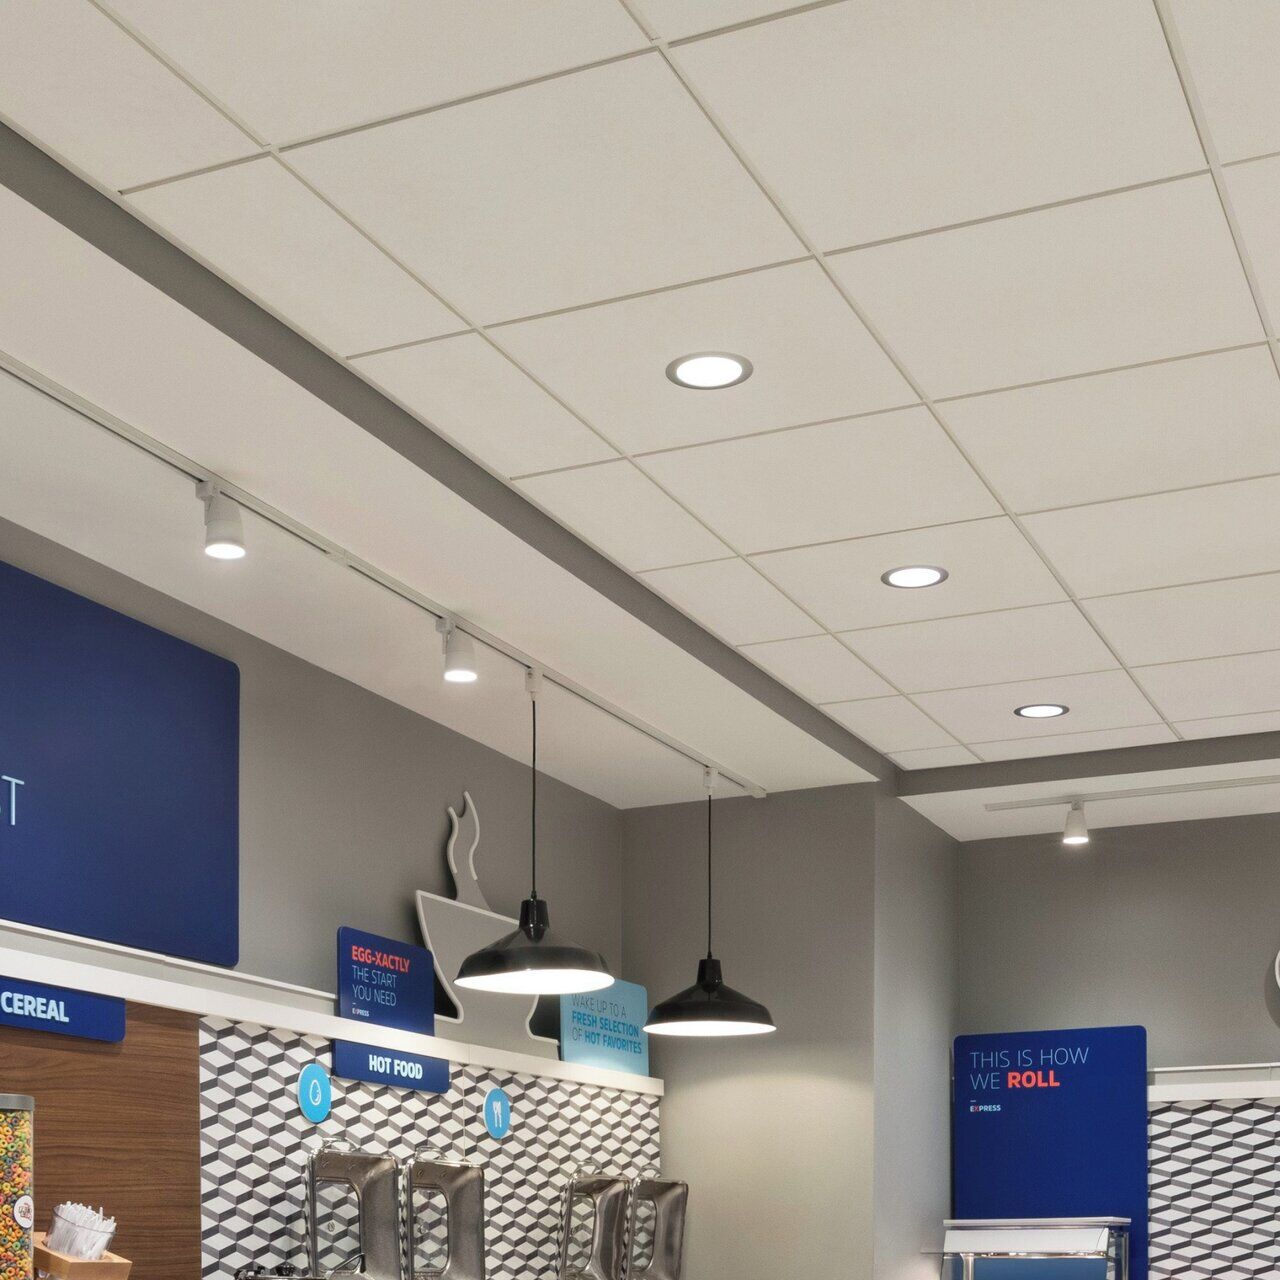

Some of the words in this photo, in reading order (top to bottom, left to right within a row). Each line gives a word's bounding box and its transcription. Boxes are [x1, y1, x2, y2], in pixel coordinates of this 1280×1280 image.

[351, 945, 410, 973] EGG-XACTLY
[352, 965, 369, 983] THE
[371, 970, 397, 988] START
[0, 991, 70, 1023] CEREAL
[352, 984, 372, 1001] YOU
[373, 989, 397, 1006] NEED
[571, 993, 594, 1011] WAKE
[597, 1000, 608, 1014] UP
[609, 1003, 619, 1017] TO
[621, 1006, 627, 1018] A
[571, 1010, 597, 1028] FRESH
[599, 1017, 639, 1038] SELECTION
[572, 1027, 583, 1041] OF
[584, 1030, 601, 1045] HOT
[602, 1034, 642, 1054] FAVORITES
[368, 1054, 392, 1074] HOT
[393, 1059, 423, 1080] FOOD
[970, 1050, 1010, 1068] THIS
[1017, 1049, 1033, 1067] IS
[1040, 1047, 1090, 1066] HOW
[970, 1072, 1001, 1090] WE
[1007, 1070, 1061, 1088] ROLL
[969, 1104, 1001, 1112] EXPRESS
